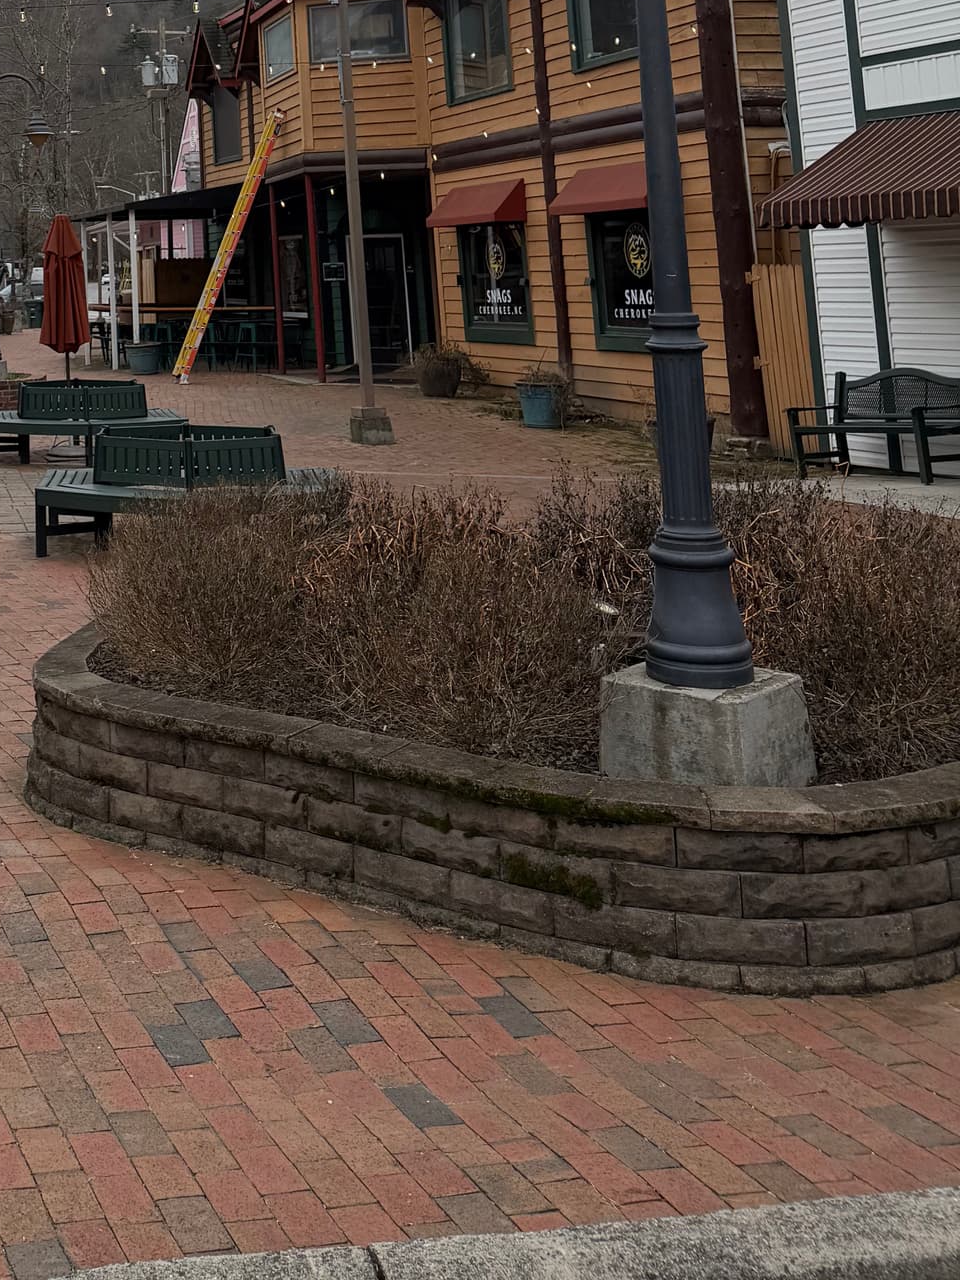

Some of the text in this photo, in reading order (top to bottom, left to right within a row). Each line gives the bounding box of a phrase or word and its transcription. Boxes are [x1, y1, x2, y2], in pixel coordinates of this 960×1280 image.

[486, 288, 512, 304] SNAGS
[624, 288, 656, 305] SNAG
[614, 308, 655, 319] CHEROKE
